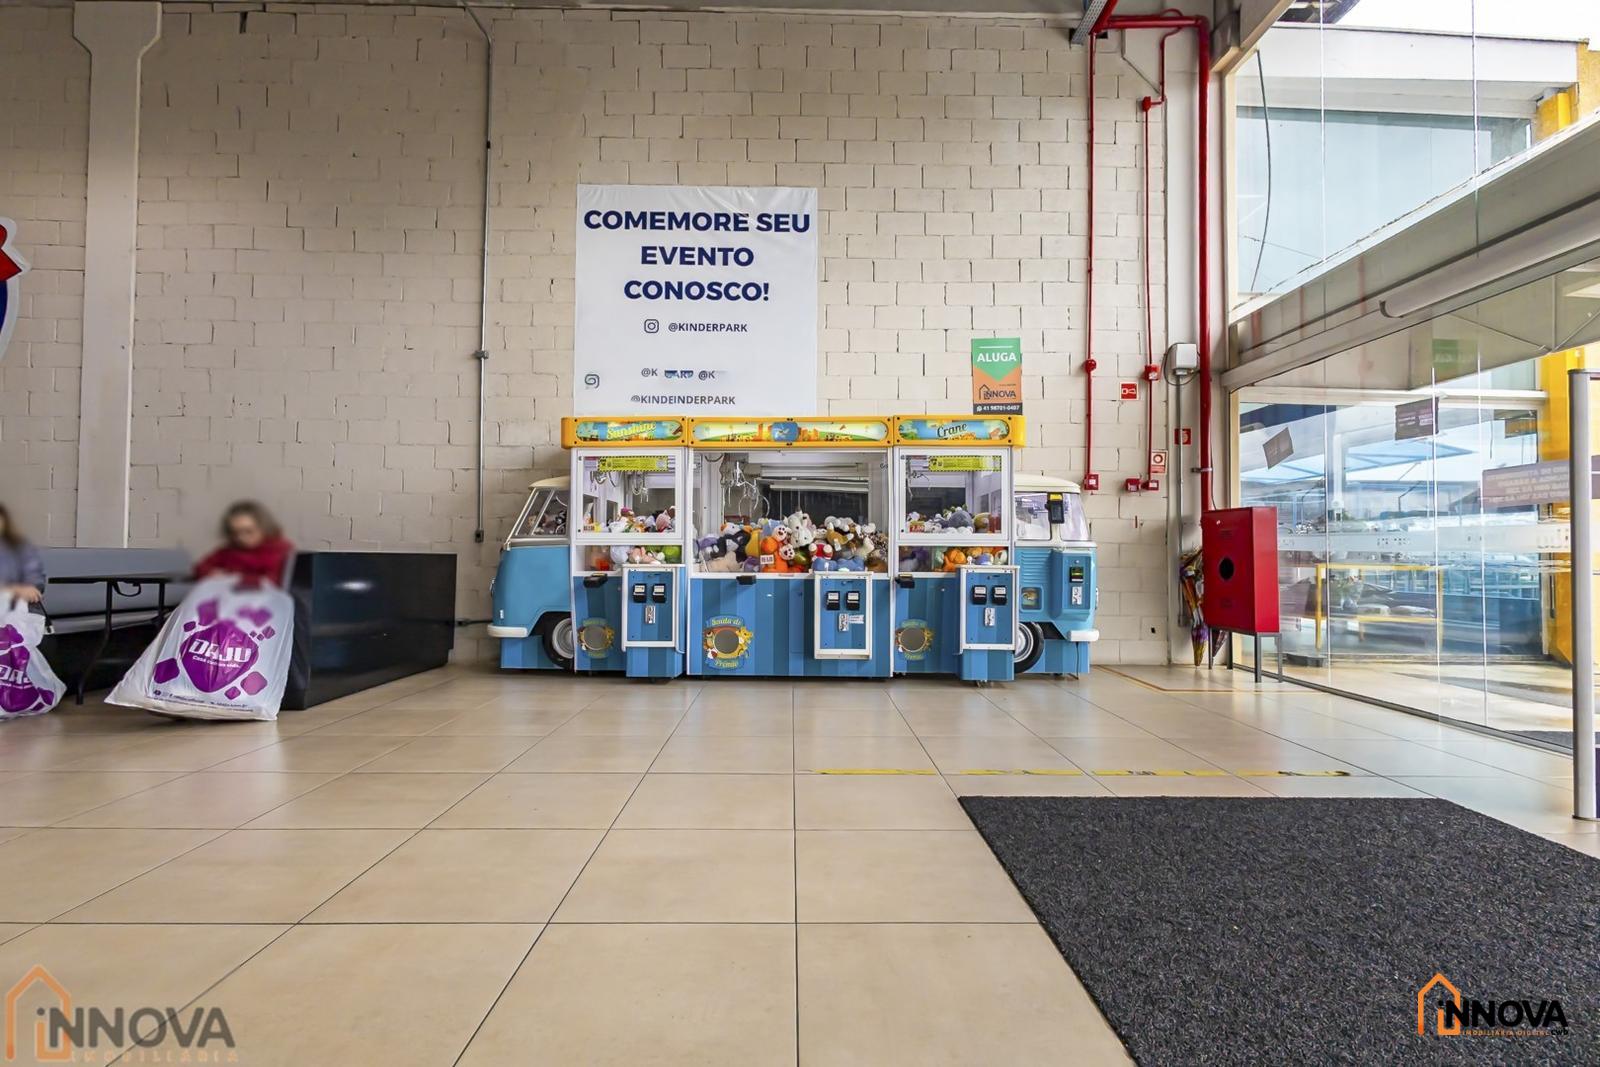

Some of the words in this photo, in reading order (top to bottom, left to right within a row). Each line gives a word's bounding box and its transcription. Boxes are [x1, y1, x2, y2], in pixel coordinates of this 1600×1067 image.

[584, 210, 749, 232] COMEMORE
[755, 213, 810, 233] SEU
[641, 246, 754, 267] EVENTO
[624, 280, 769, 301] CONOSCO!
[668, 322, 748, 333] @KINDERPARK
[977, 352, 1017, 362] ALUGA
[937, 423, 967, 438] Crane
[188, 639, 252, 663] DAJU
